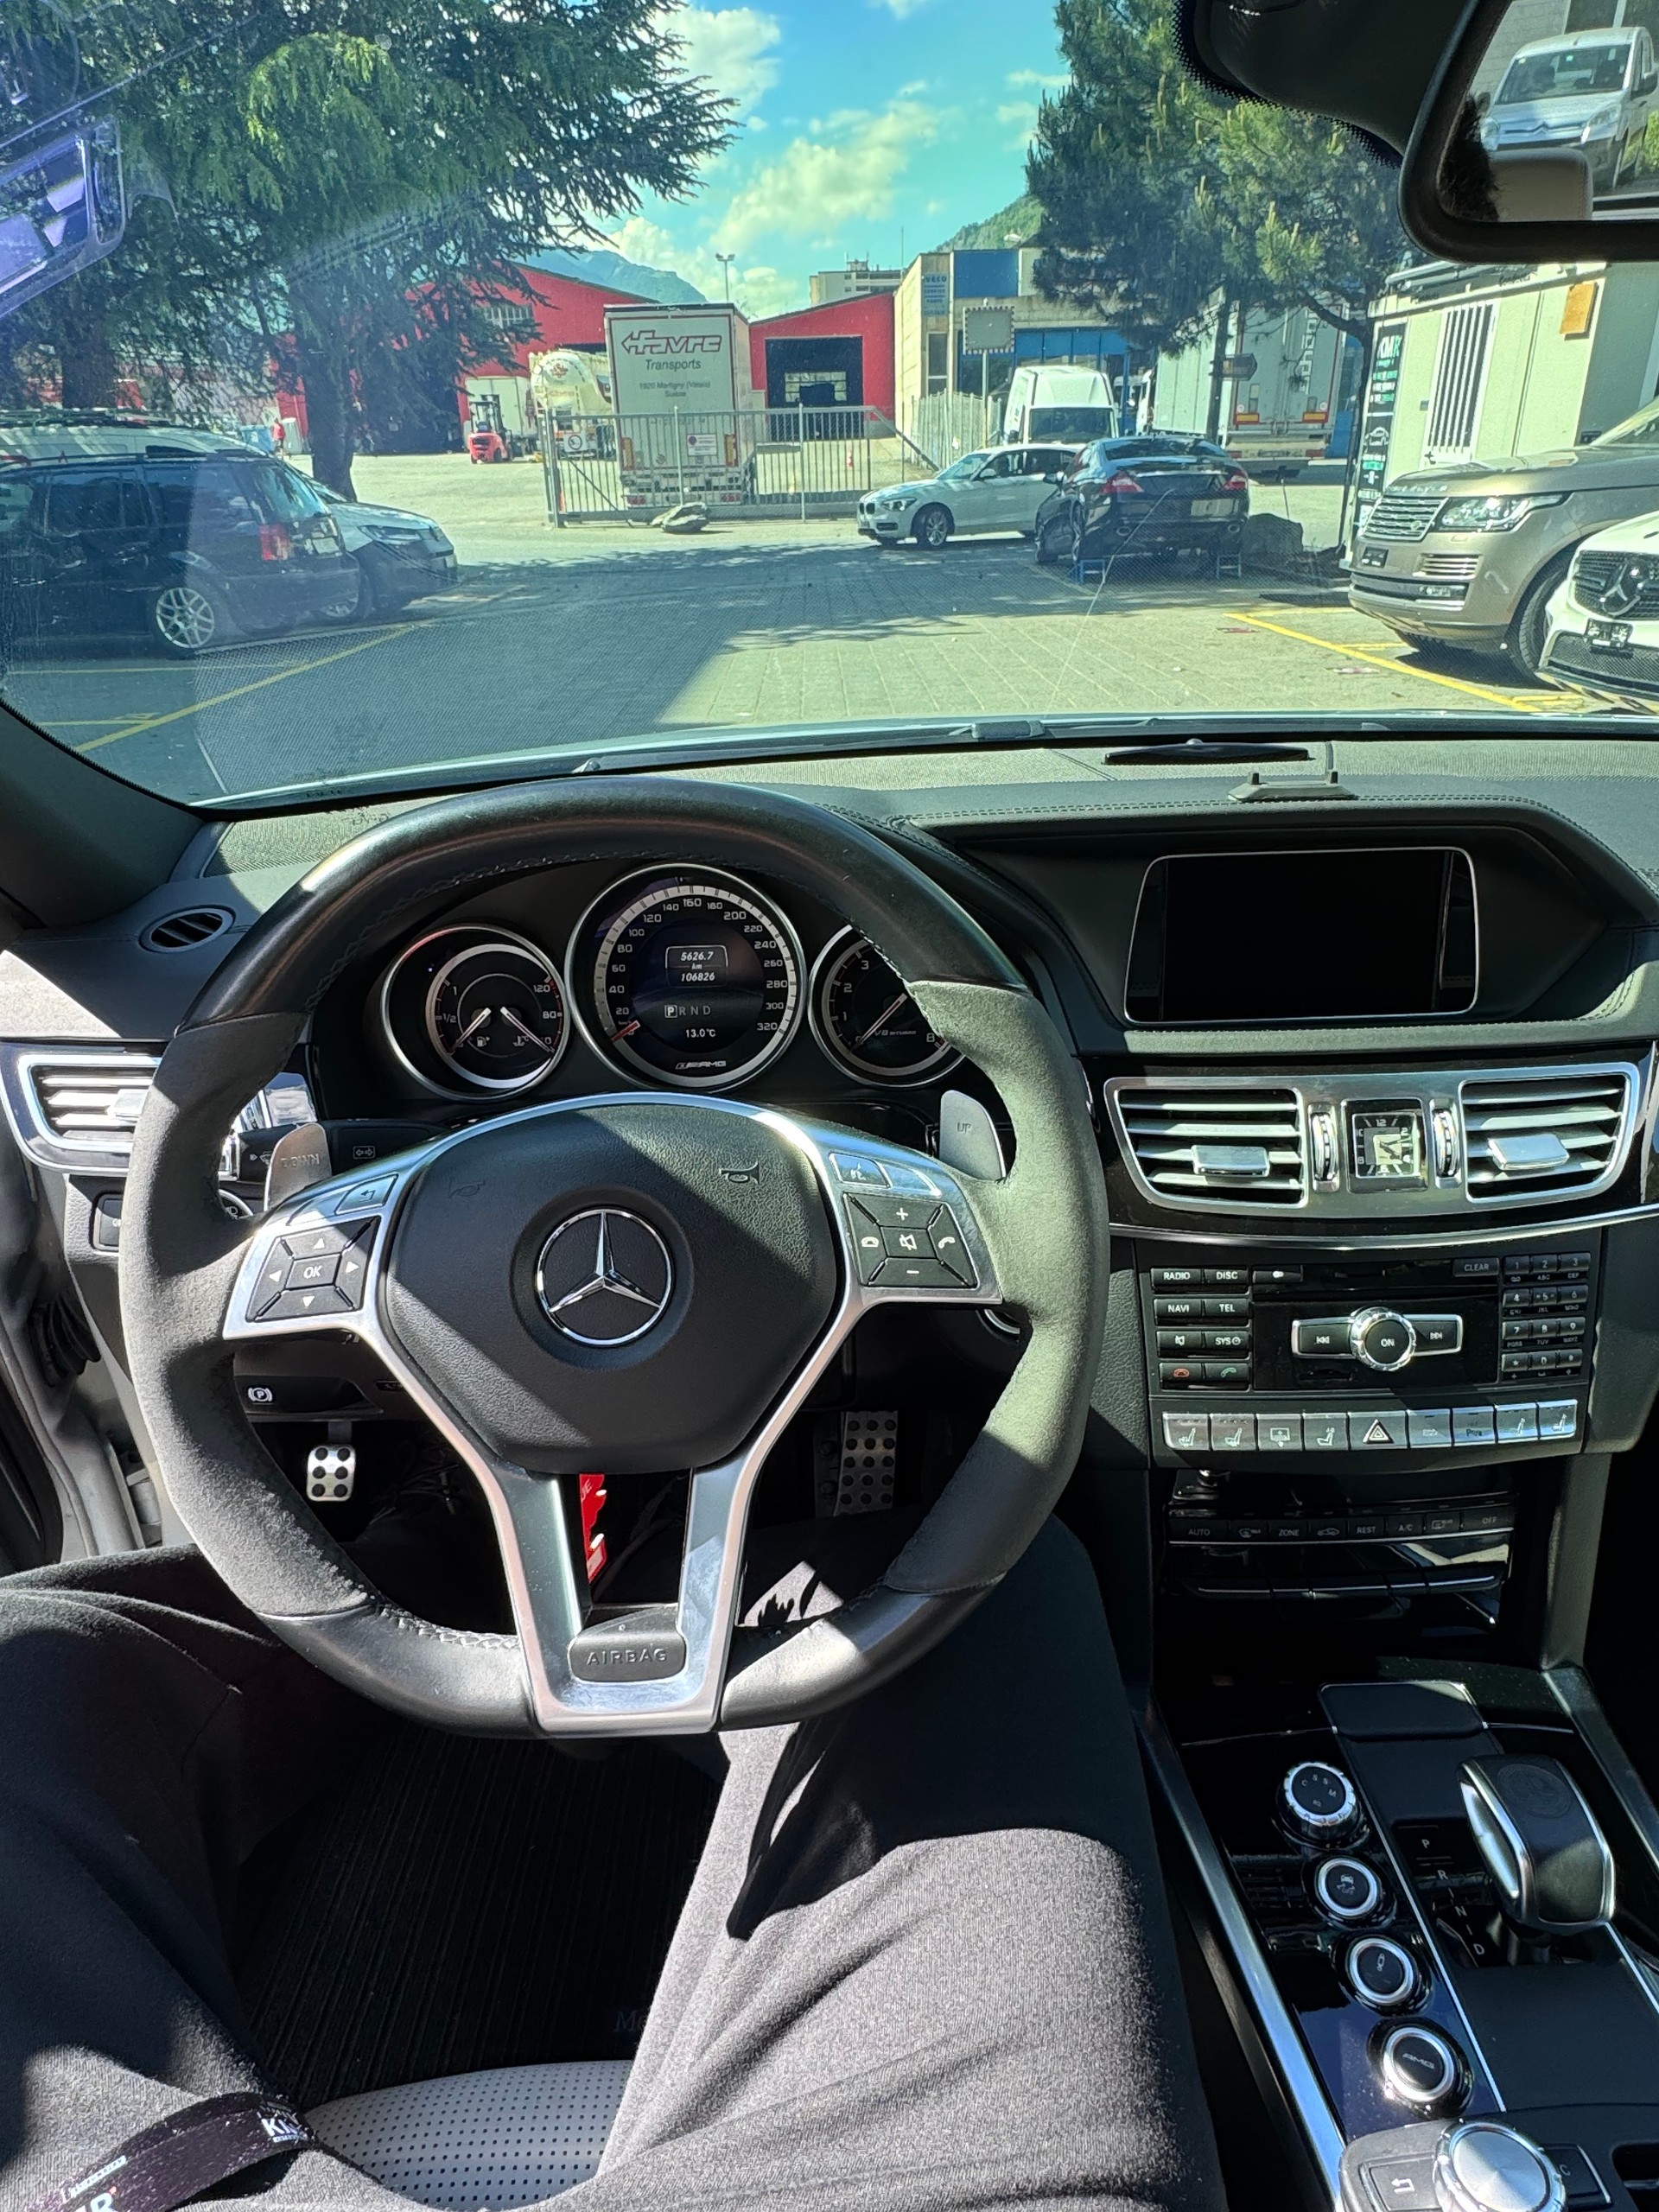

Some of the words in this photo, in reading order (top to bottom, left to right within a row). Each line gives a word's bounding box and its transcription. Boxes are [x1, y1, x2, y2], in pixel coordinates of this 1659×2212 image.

[645, 359, 702, 372] Transports
[657, 381, 684, 391] Martigny
[683, 898, 702, 907] 160
[707, 901, 723, 910] 180
[663, 903, 680, 912] 140
[643, 913, 662, 923] 120
[723, 911, 747, 920] 200
[628, 928, 645, 937] 100
[744, 925, 763, 933] 220
[617, 944, 633, 953] 80
[754, 940, 777, 950] 240
[680, 951, 714, 962] 5626.7
[764, 959, 783, 968] 260
[861, 960, 869, 969] 3
[612, 964, 626, 973] 60
[681, 972, 715, 982] 106826
[533, 984, 550, 993] 120
[766, 980, 788, 988] 280
[843, 982, 853, 993] 2
[453, 986, 458, 995] 1
[608, 985, 625, 994] 40
[766, 1001, 785, 1010] 300
[543, 1010, 556, 1019] 80
[666, 1006, 676, 1017] P
[679, 1005, 687, 1015] R
[690, 1005, 699, 1015] N
[703, 1005, 711, 1015] D
[442, 1013, 457, 1023] 1/2
[842, 1011, 848, 1021] 1
[756, 1022, 778, 1031] 320
[925, 1033, 936, 1043] 8
[1376, 1118, 1387, 1127] 12
[957, 1122, 972, 1134] UP
[1401, 1127, 1409, 1136] 2
[1464, 1262, 1490, 1272] CLEAR
[1541, 1260, 1548, 1269] 2
[1573, 1258, 1579, 1267] 3
[303, 1265, 323, 1280] OK
[1163, 1271, 1191, 1281] RADIO
[1216, 1271, 1238, 1281] DISC
[1514, 1294, 1520, 1302] 4
[1542, 1293, 1548, 1301] 5
[1167, 1304, 1190, 1313] NAVI
[1219, 1303, 1236, 1313] TEL
[1215, 1336, 1231, 1345] SYS
[1380, 1338, 1395, 1348] ON
[1541, 1356, 1548, 1364] 0
[1482, 1516, 1498, 1525] OFF
[1187, 1527, 1211, 1537] AUTO
[1356, 1525, 1376, 1535] REST
[1398, 1522, 1414, 1533] A/C
[1278, 1528, 1300, 1537] ZONE
[586, 1648, 668, 1667] AIRBAG
[1421, 1839, 1430, 1848] P
[1437, 1869, 1448, 1880] R
[1454, 1905, 1468, 1916] N
[1473, 1943, 1485, 1955] D
[1402, 2052, 1435, 2069] AMG
[1559, 2164, 1572, 2177] C
